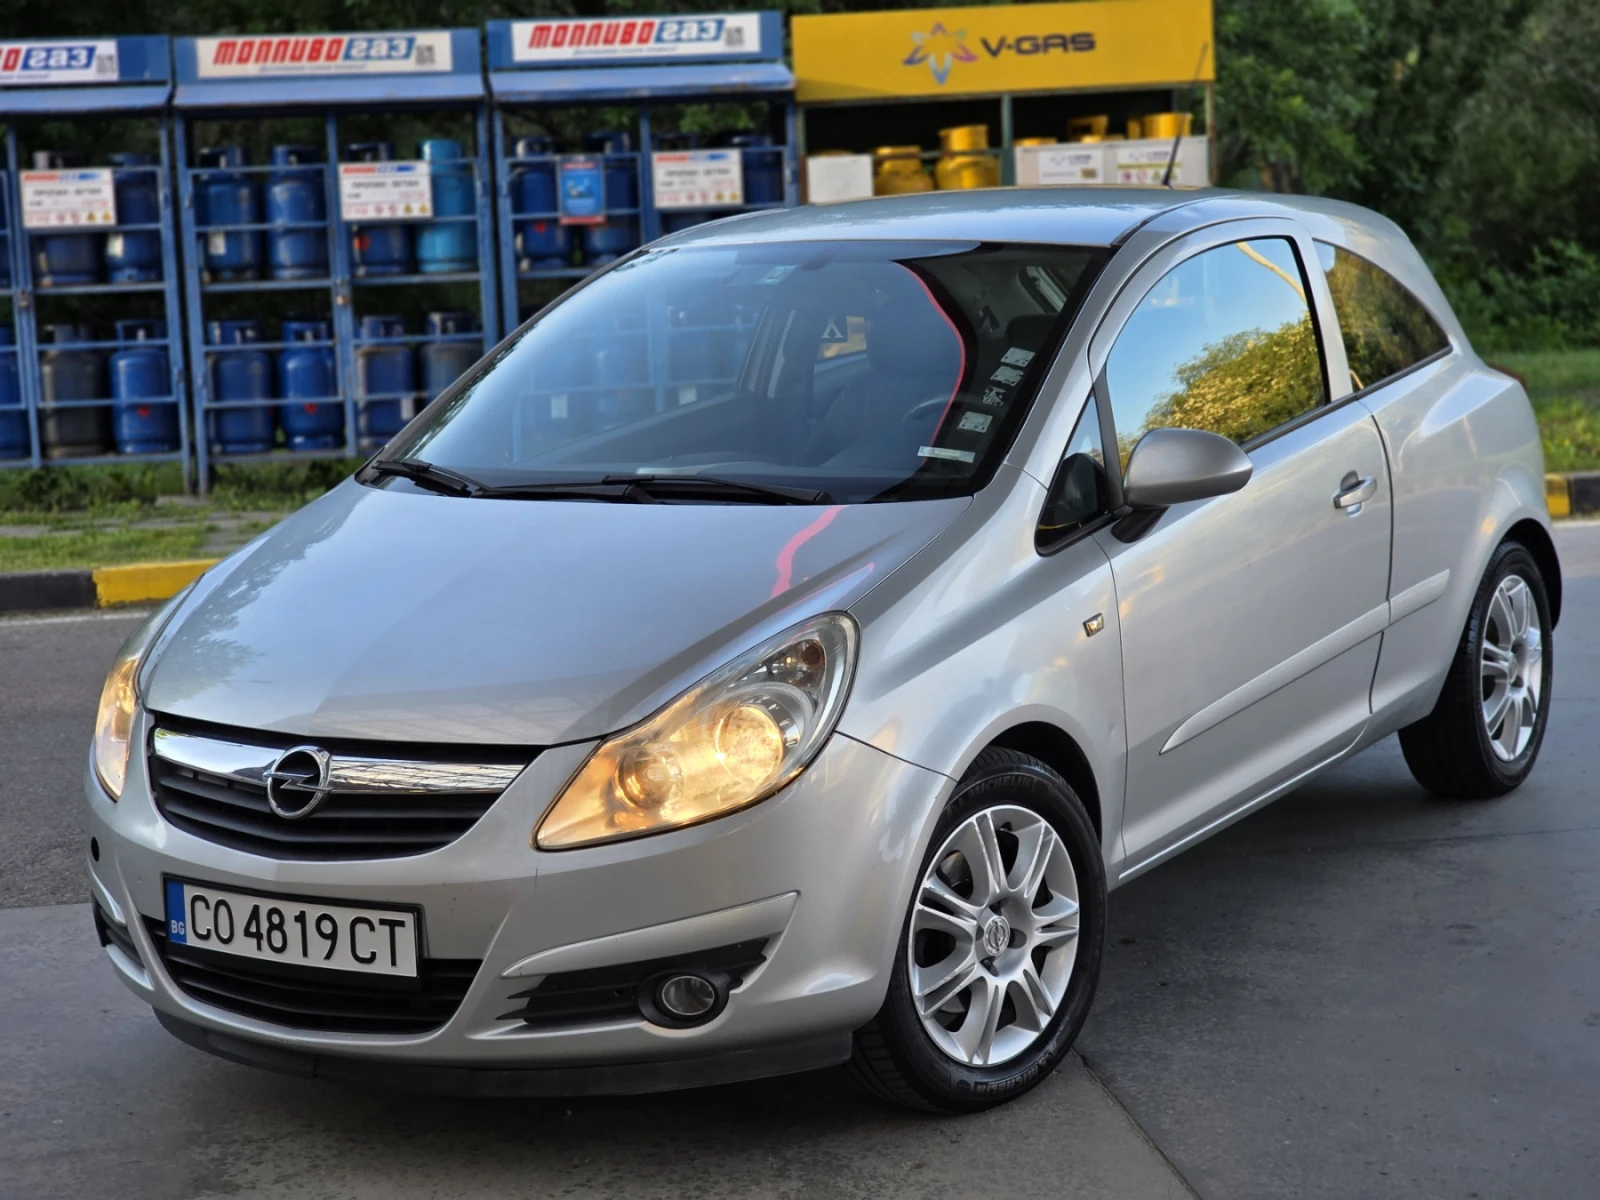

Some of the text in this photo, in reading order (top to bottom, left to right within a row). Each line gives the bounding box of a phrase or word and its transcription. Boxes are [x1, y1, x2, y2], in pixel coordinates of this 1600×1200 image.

[980, 32, 1096, 57] V-GAS
[968, 776, 1034, 798] MICHELIN
[170, 919, 185, 936] BG
[243, 903, 339, 960] 4819
